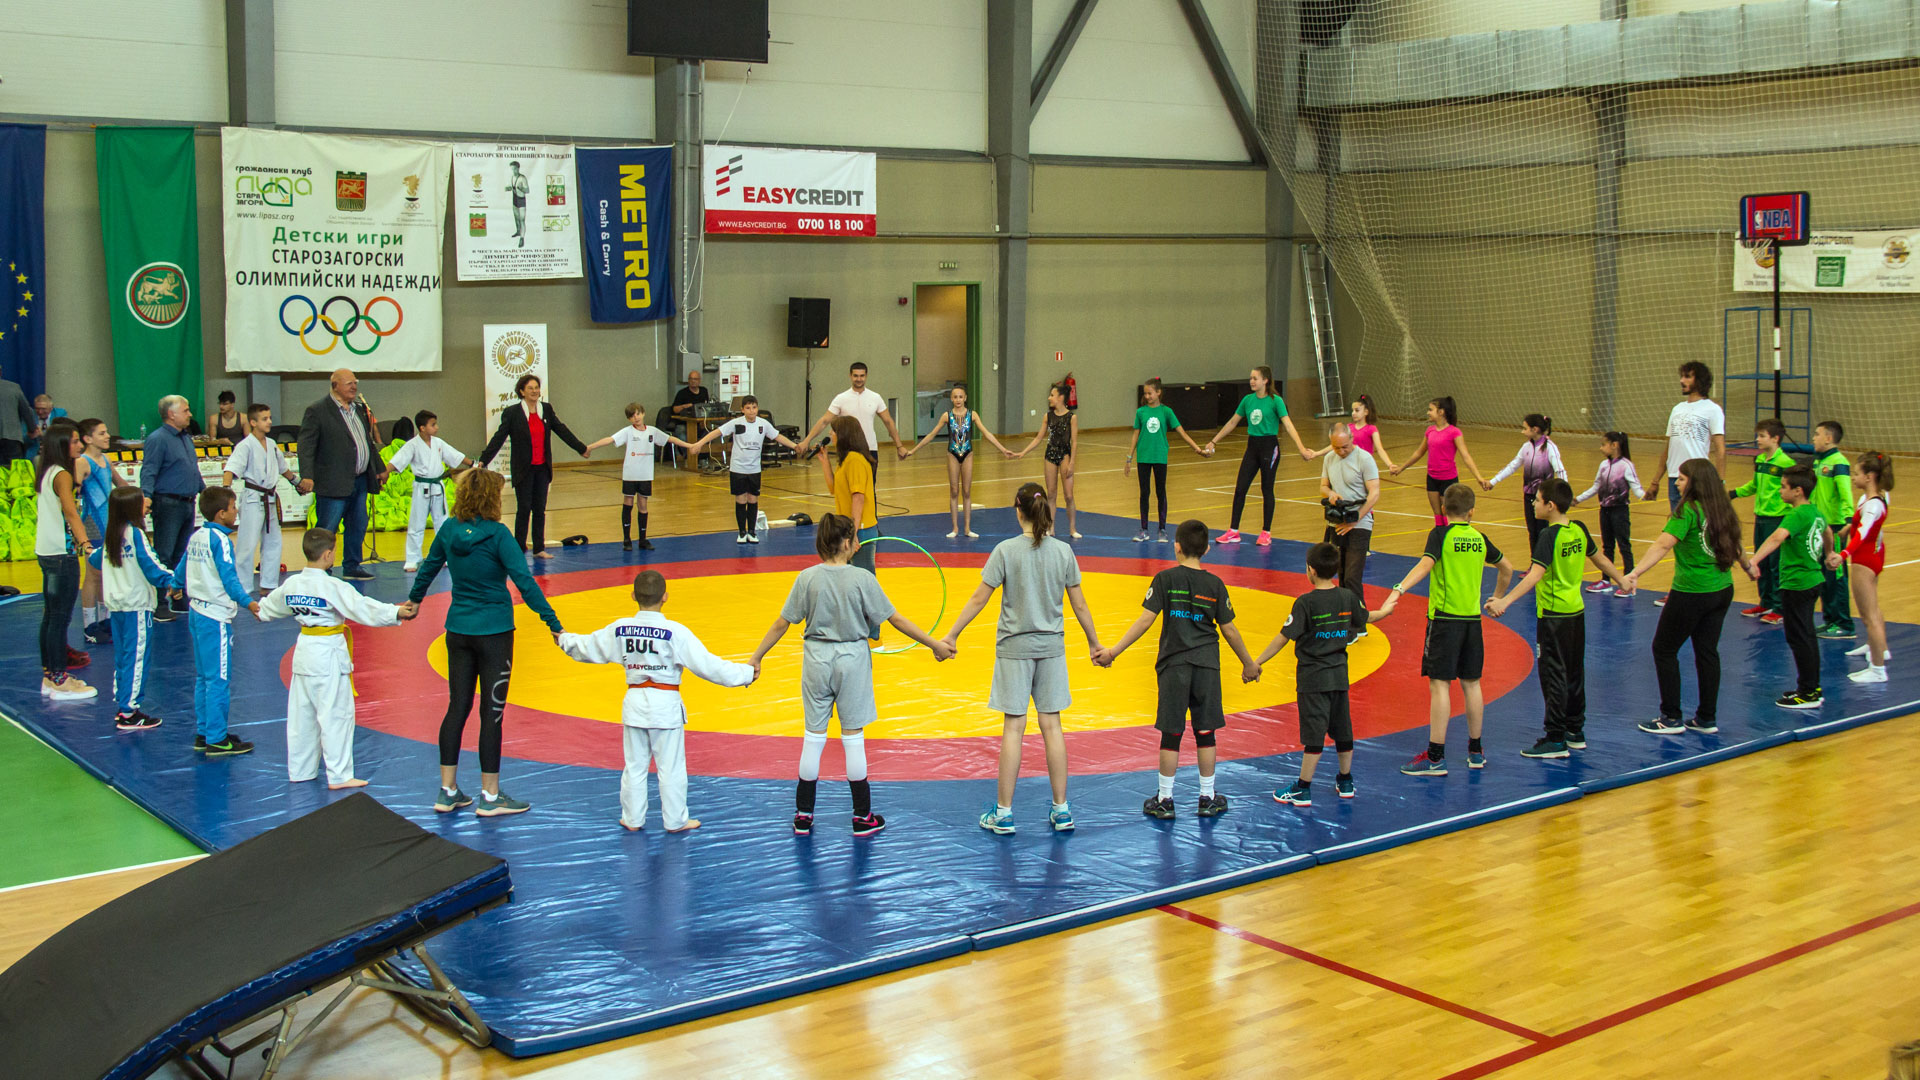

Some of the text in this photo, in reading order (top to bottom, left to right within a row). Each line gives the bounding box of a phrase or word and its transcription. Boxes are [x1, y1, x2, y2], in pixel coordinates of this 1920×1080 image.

[235, 165, 312, 177] граждански клуб
[743, 186, 864, 206] EASYCREDIT
[236, 211, 295, 221] www.lipasz.org
[718, 218, 864, 231] WWW.EASYCREDIT.BG 0700 18 100
[1762, 208, 1791, 229] NBA
[272, 226, 403, 248] Детски игри
[599, 199, 611, 277] Cash & Carry
[618, 164, 652, 309] METRO
[272, 248, 404, 267] СТАРОЗАГОРСКИ
[235, 269, 441, 292] ОЛИМПИЙСКИ НАДЕЖДИ
[1454, 542, 1482, 553] БЕРОЕ
[1561, 543, 1582, 557] БЕРОЕ
[619, 626, 667, 639] I.MIHAILOV
[625, 638, 659, 655] BUL
